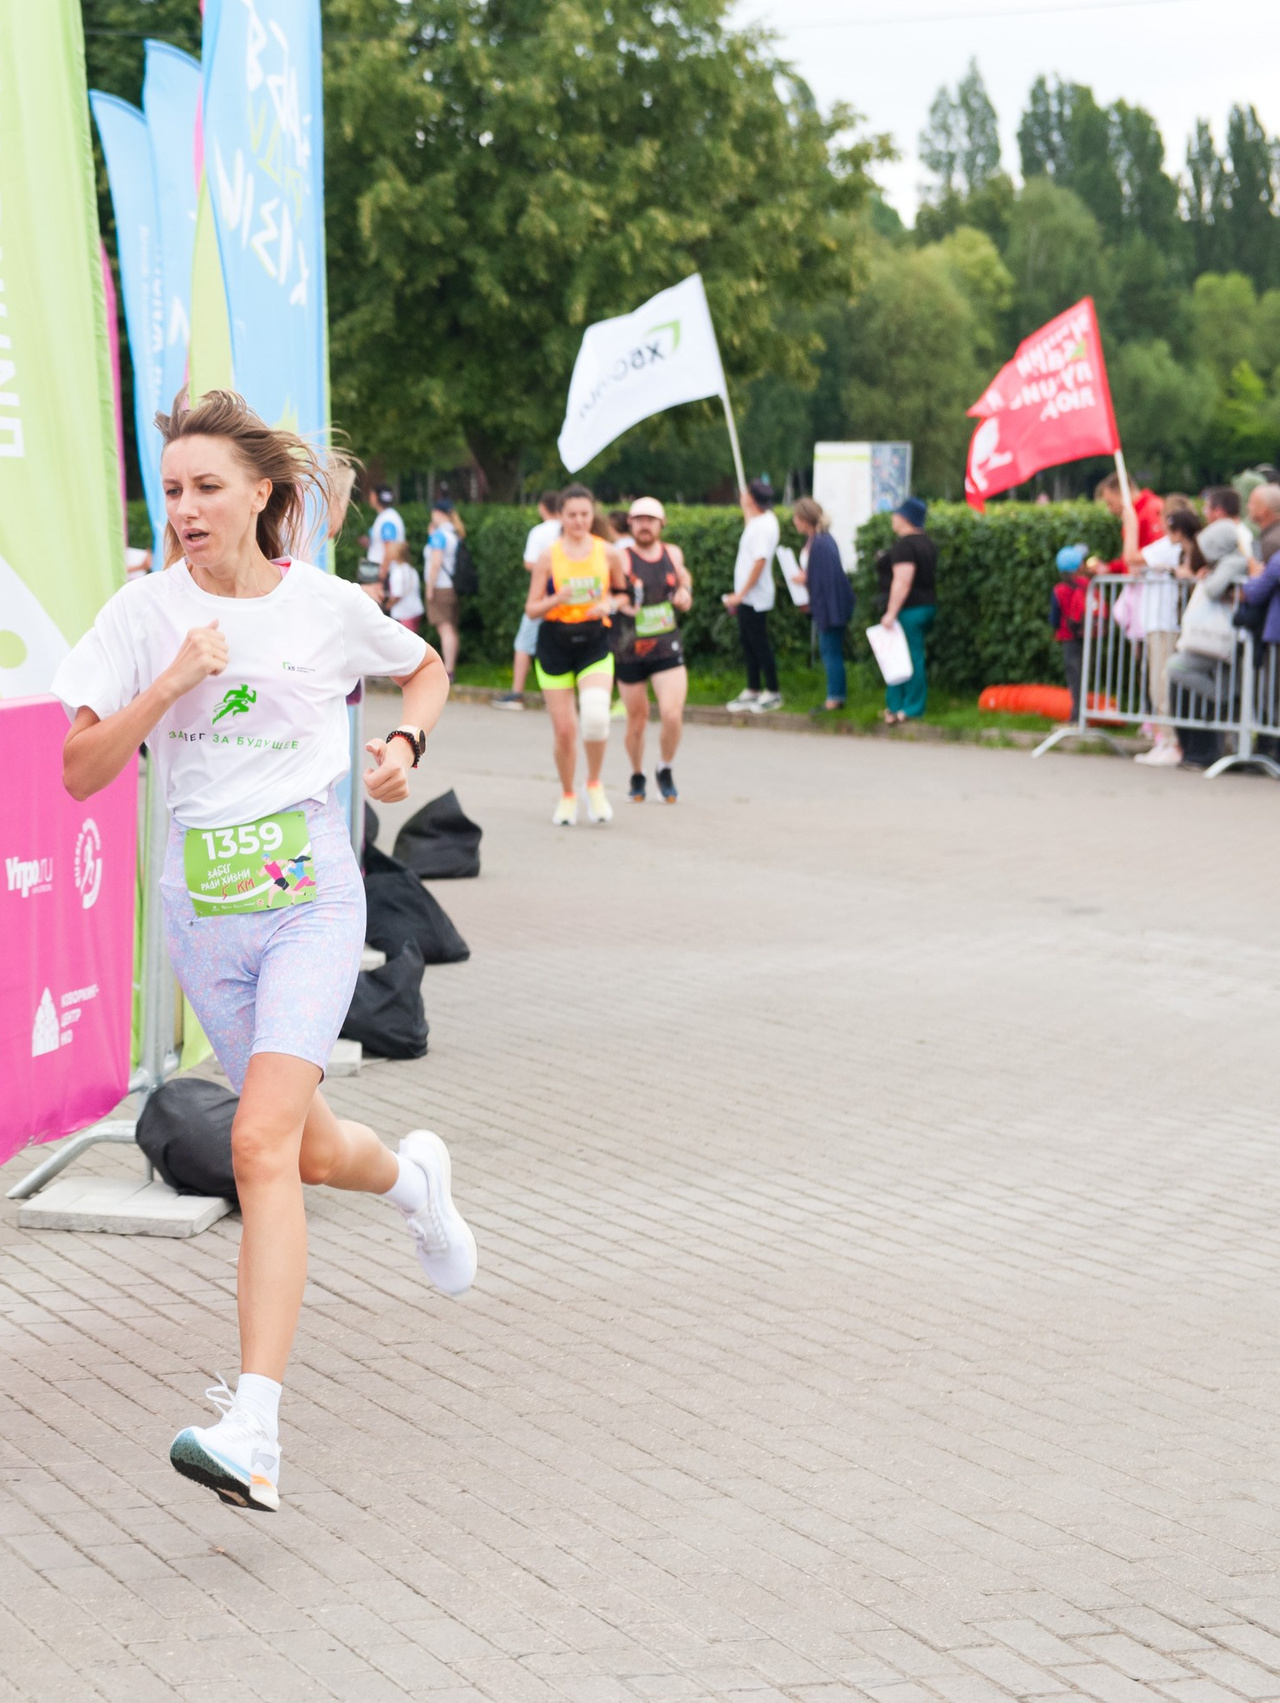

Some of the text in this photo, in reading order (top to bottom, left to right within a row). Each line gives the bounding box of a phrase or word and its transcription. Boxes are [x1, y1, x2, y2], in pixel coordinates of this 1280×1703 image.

[212, 733, 230, 744] ЗА
[236, 736, 300, 750] БУДУЩЕЕ
[202, 821, 283, 860] 1359
[201, 867, 251, 891] РАДИ ЖИЗНИ
[207, 863, 232, 880] ЗАБЕГ
